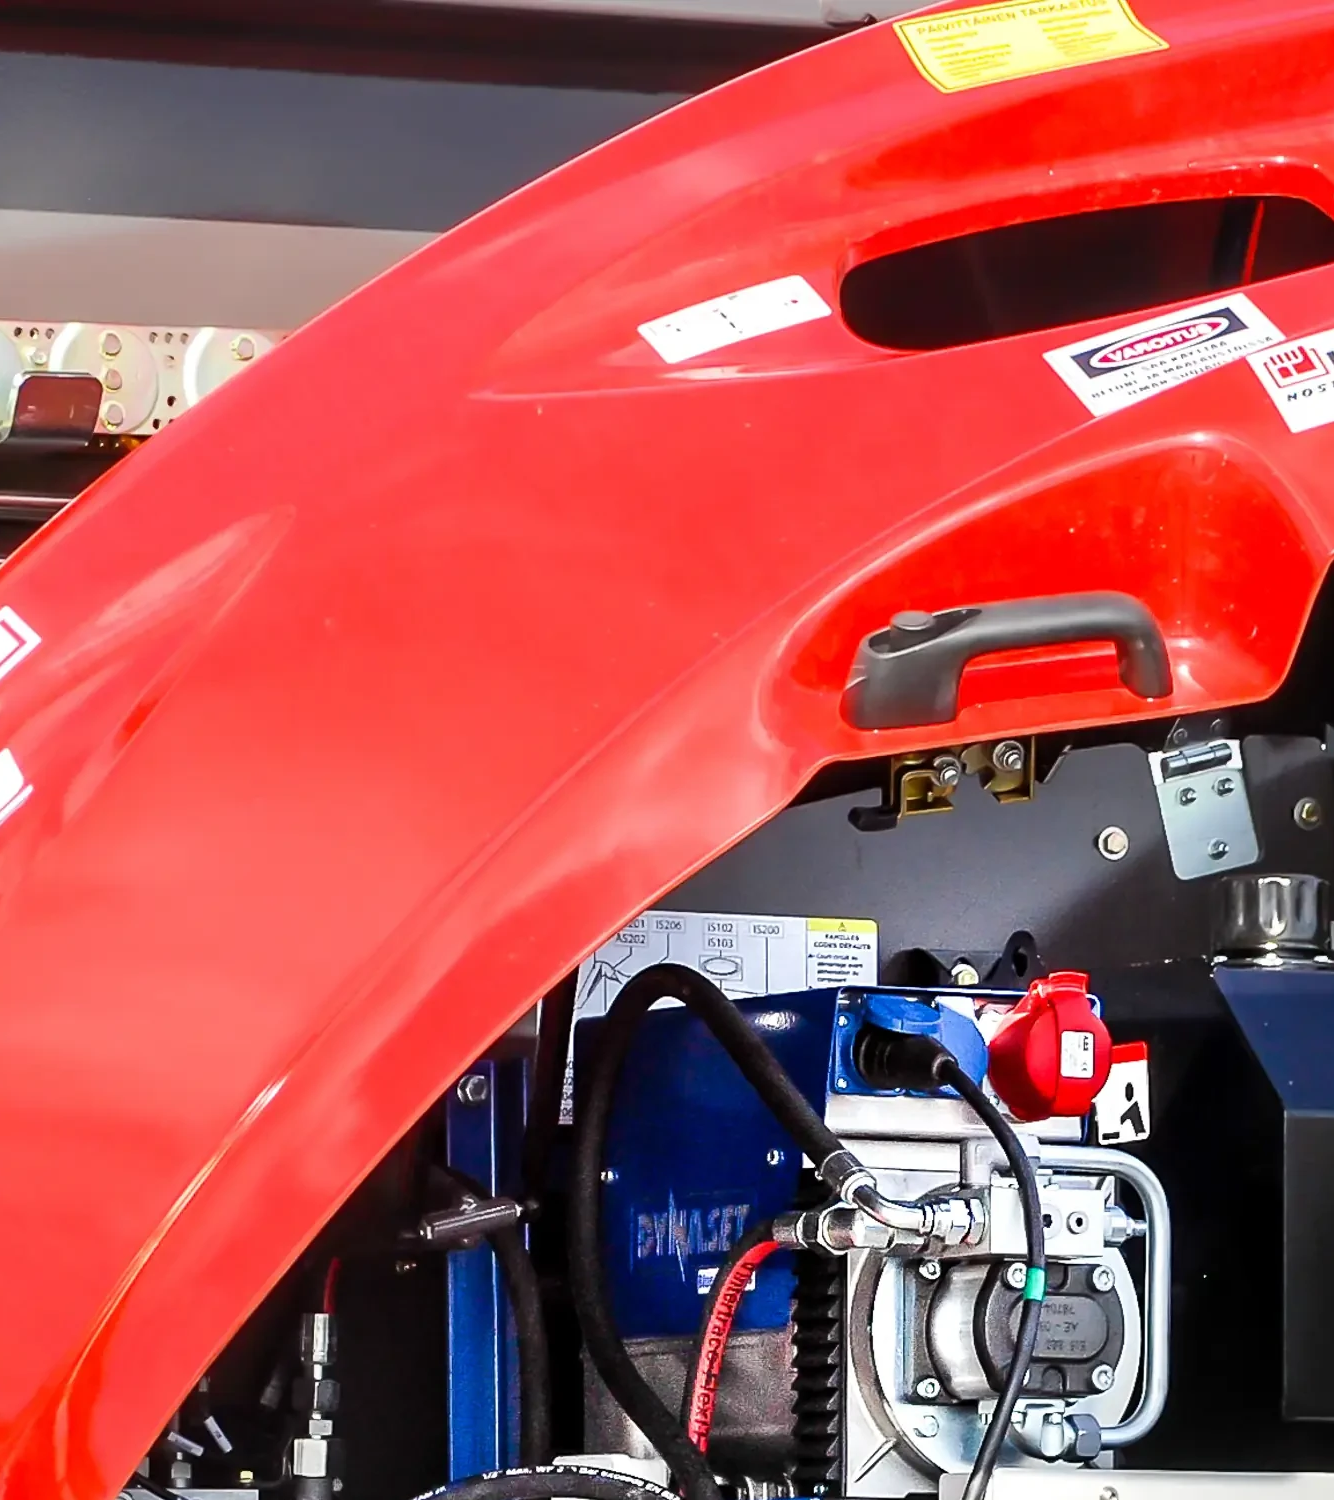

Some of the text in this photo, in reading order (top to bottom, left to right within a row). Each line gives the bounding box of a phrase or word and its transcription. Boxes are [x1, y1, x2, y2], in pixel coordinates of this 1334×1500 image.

[1107, 322, 1213, 363] VAROITUS
[655, 919, 682, 931] IS206
[707, 922, 734, 934] IS102
[752, 924, 780, 935] IS200
[707, 937, 734, 949] IS103
[637, 1194, 751, 1272] DYNASET
